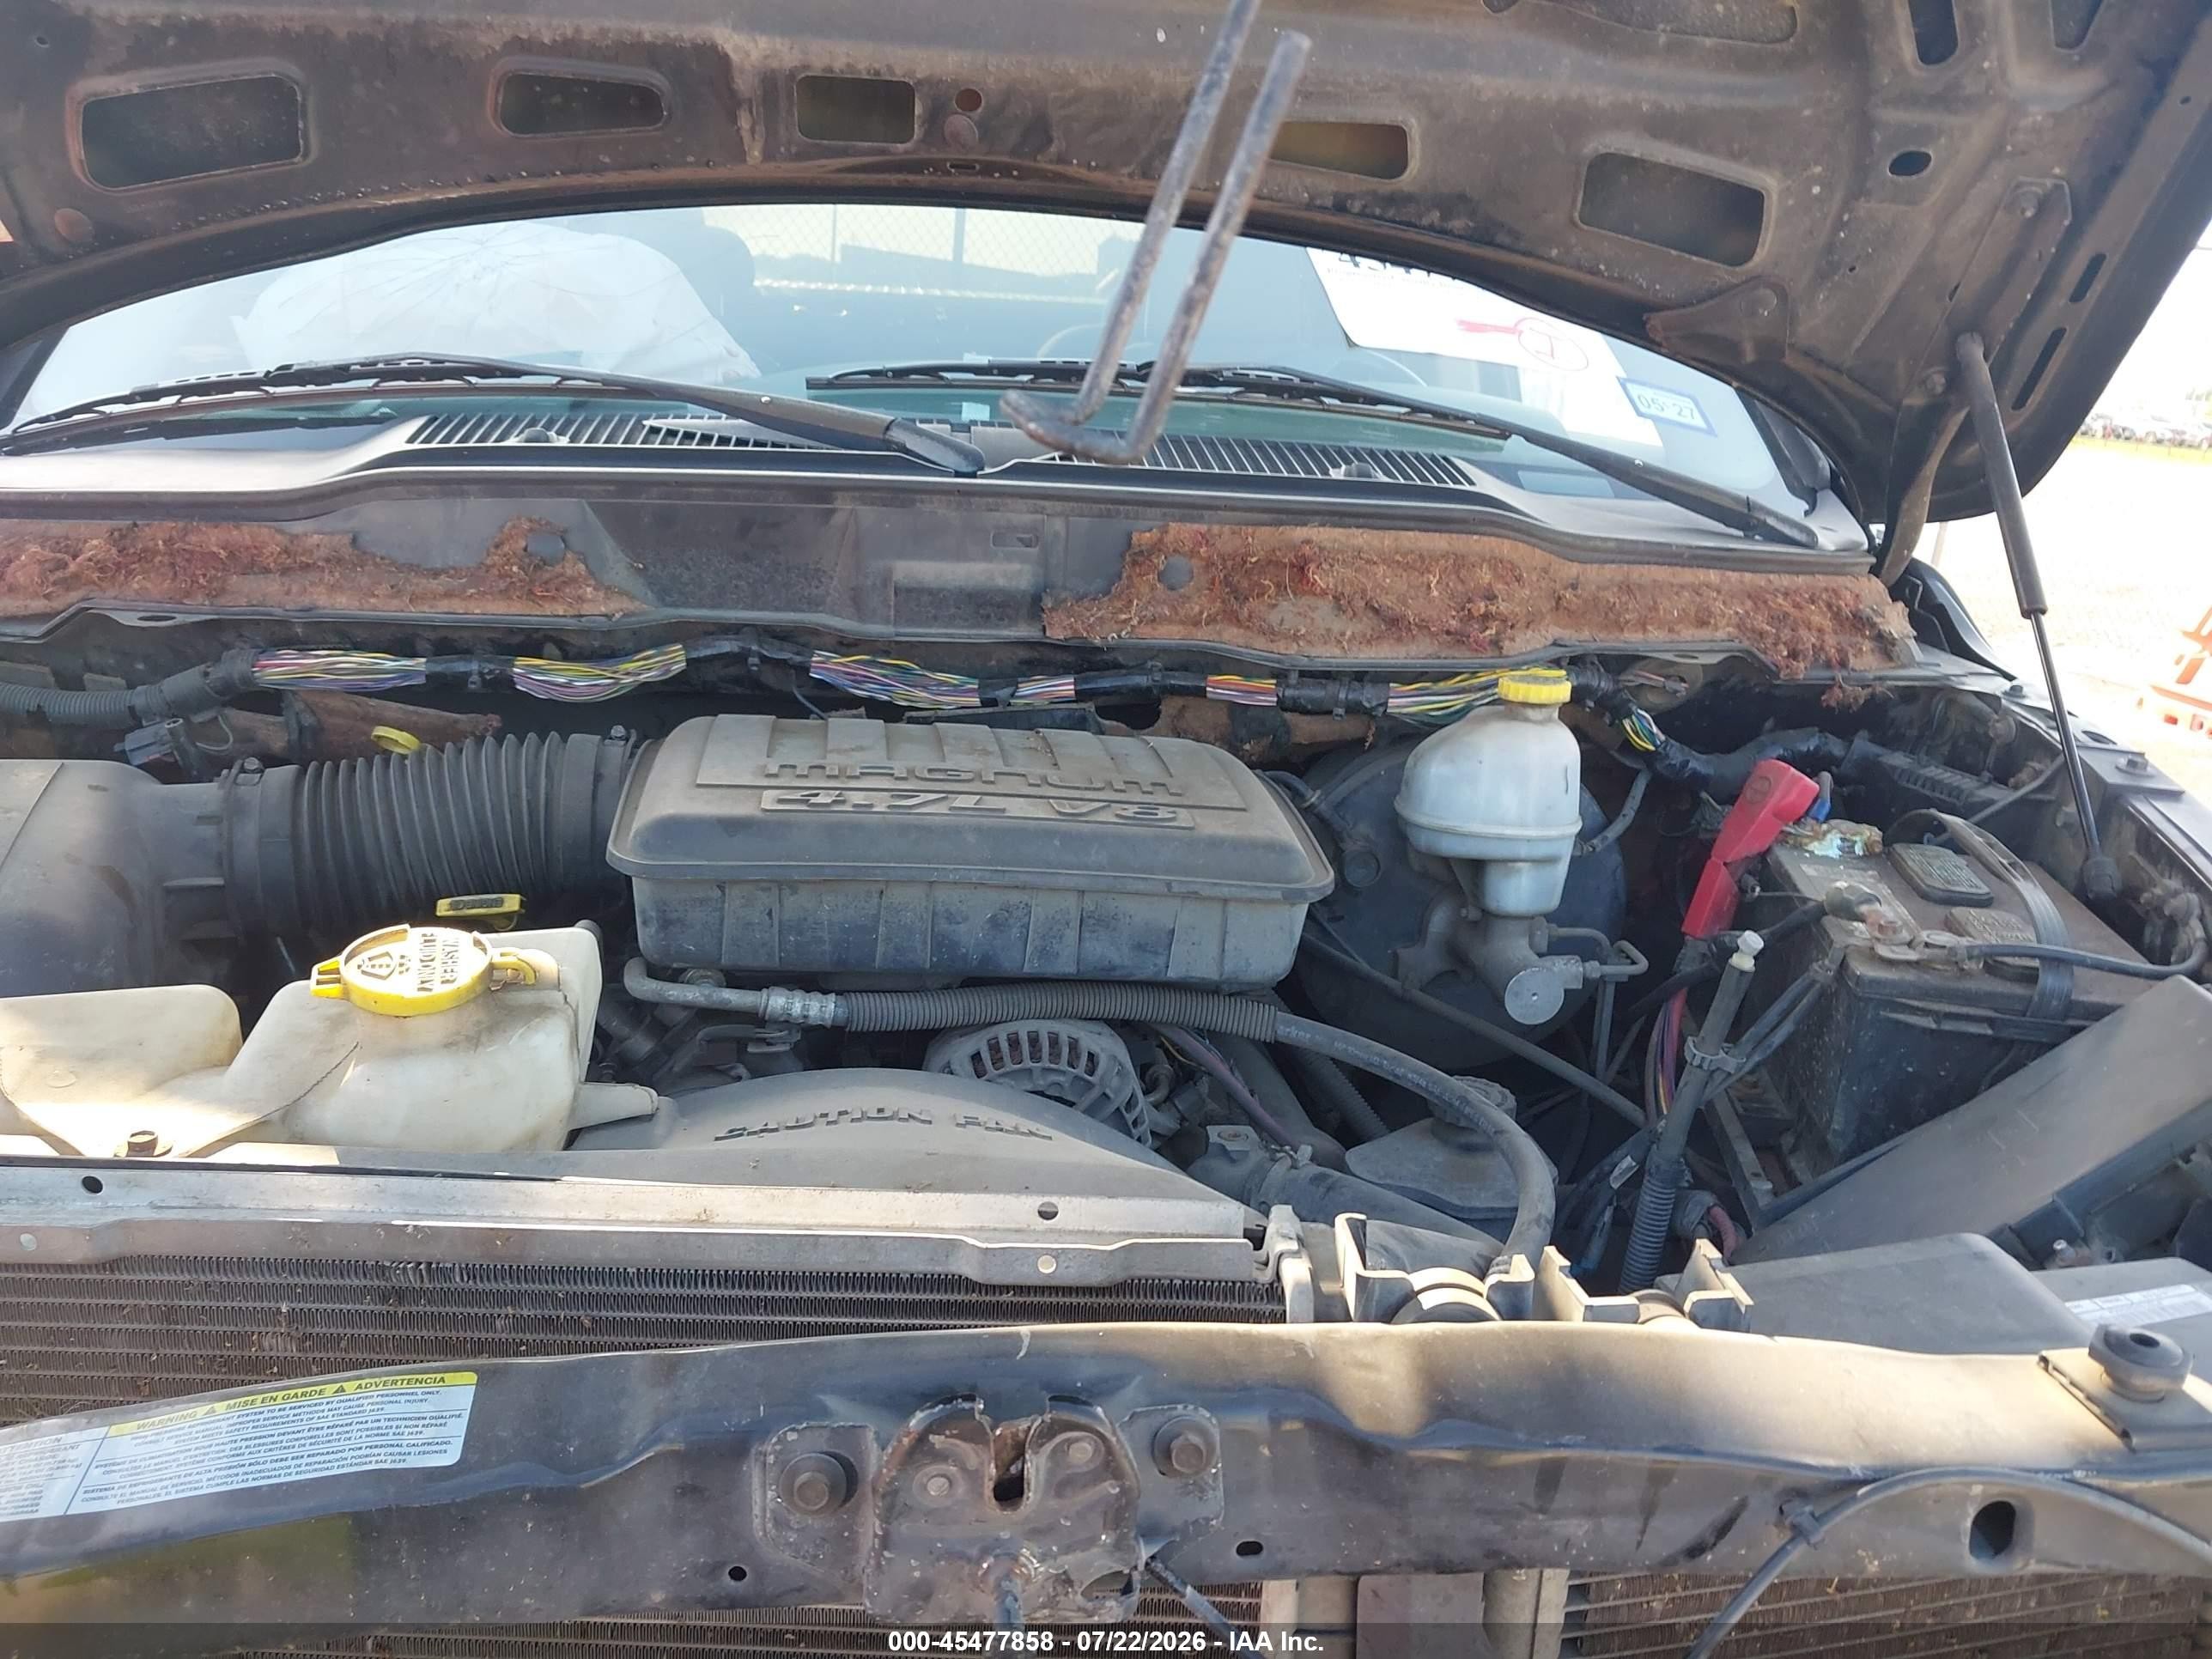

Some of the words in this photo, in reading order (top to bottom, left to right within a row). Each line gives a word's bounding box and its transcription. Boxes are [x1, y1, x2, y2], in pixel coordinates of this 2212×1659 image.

[775, 790, 1006, 813] 4.7L
[1049, 799, 1178, 822] V8
[714, 1108, 933, 1141] CAUTION
[955, 1115, 1053, 1141] FAN
[137, 1411, 198, 1430] WARNING
[225, 1399, 257, 1411] MISE
[260, 1395, 278, 1404] EN
[282, 1389, 326, 1401] GARDE
[354, 1376, 446, 1391] ADVERTENCIA
[0, 1437, 63, 1454] TTENTION
